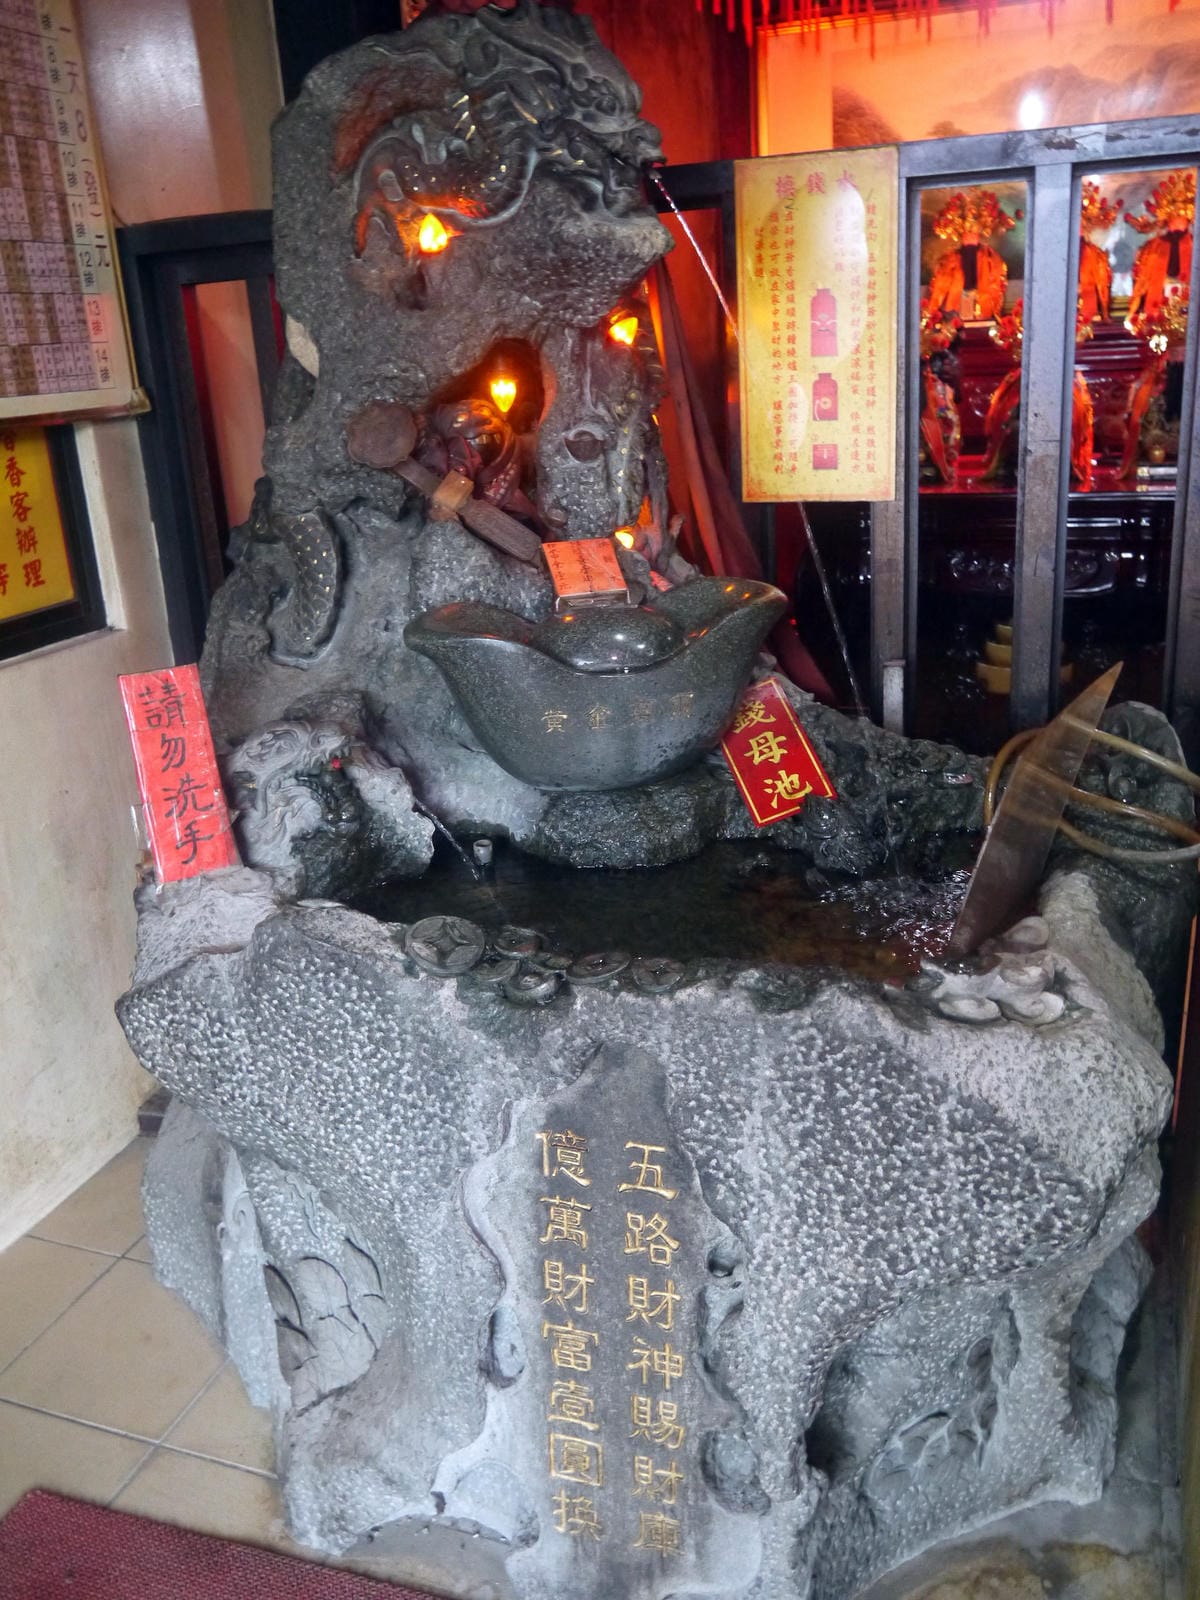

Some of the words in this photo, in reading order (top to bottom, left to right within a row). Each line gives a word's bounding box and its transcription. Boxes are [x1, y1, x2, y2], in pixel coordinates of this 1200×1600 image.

[138, 679, 214, 865] 請勿洗手
[733, 700, 814, 809] 錢母池
[535, 1129, 606, 1542] 億萬財富壹圓換
[617, 1140, 685, 1558] 五路財神賜財庫
